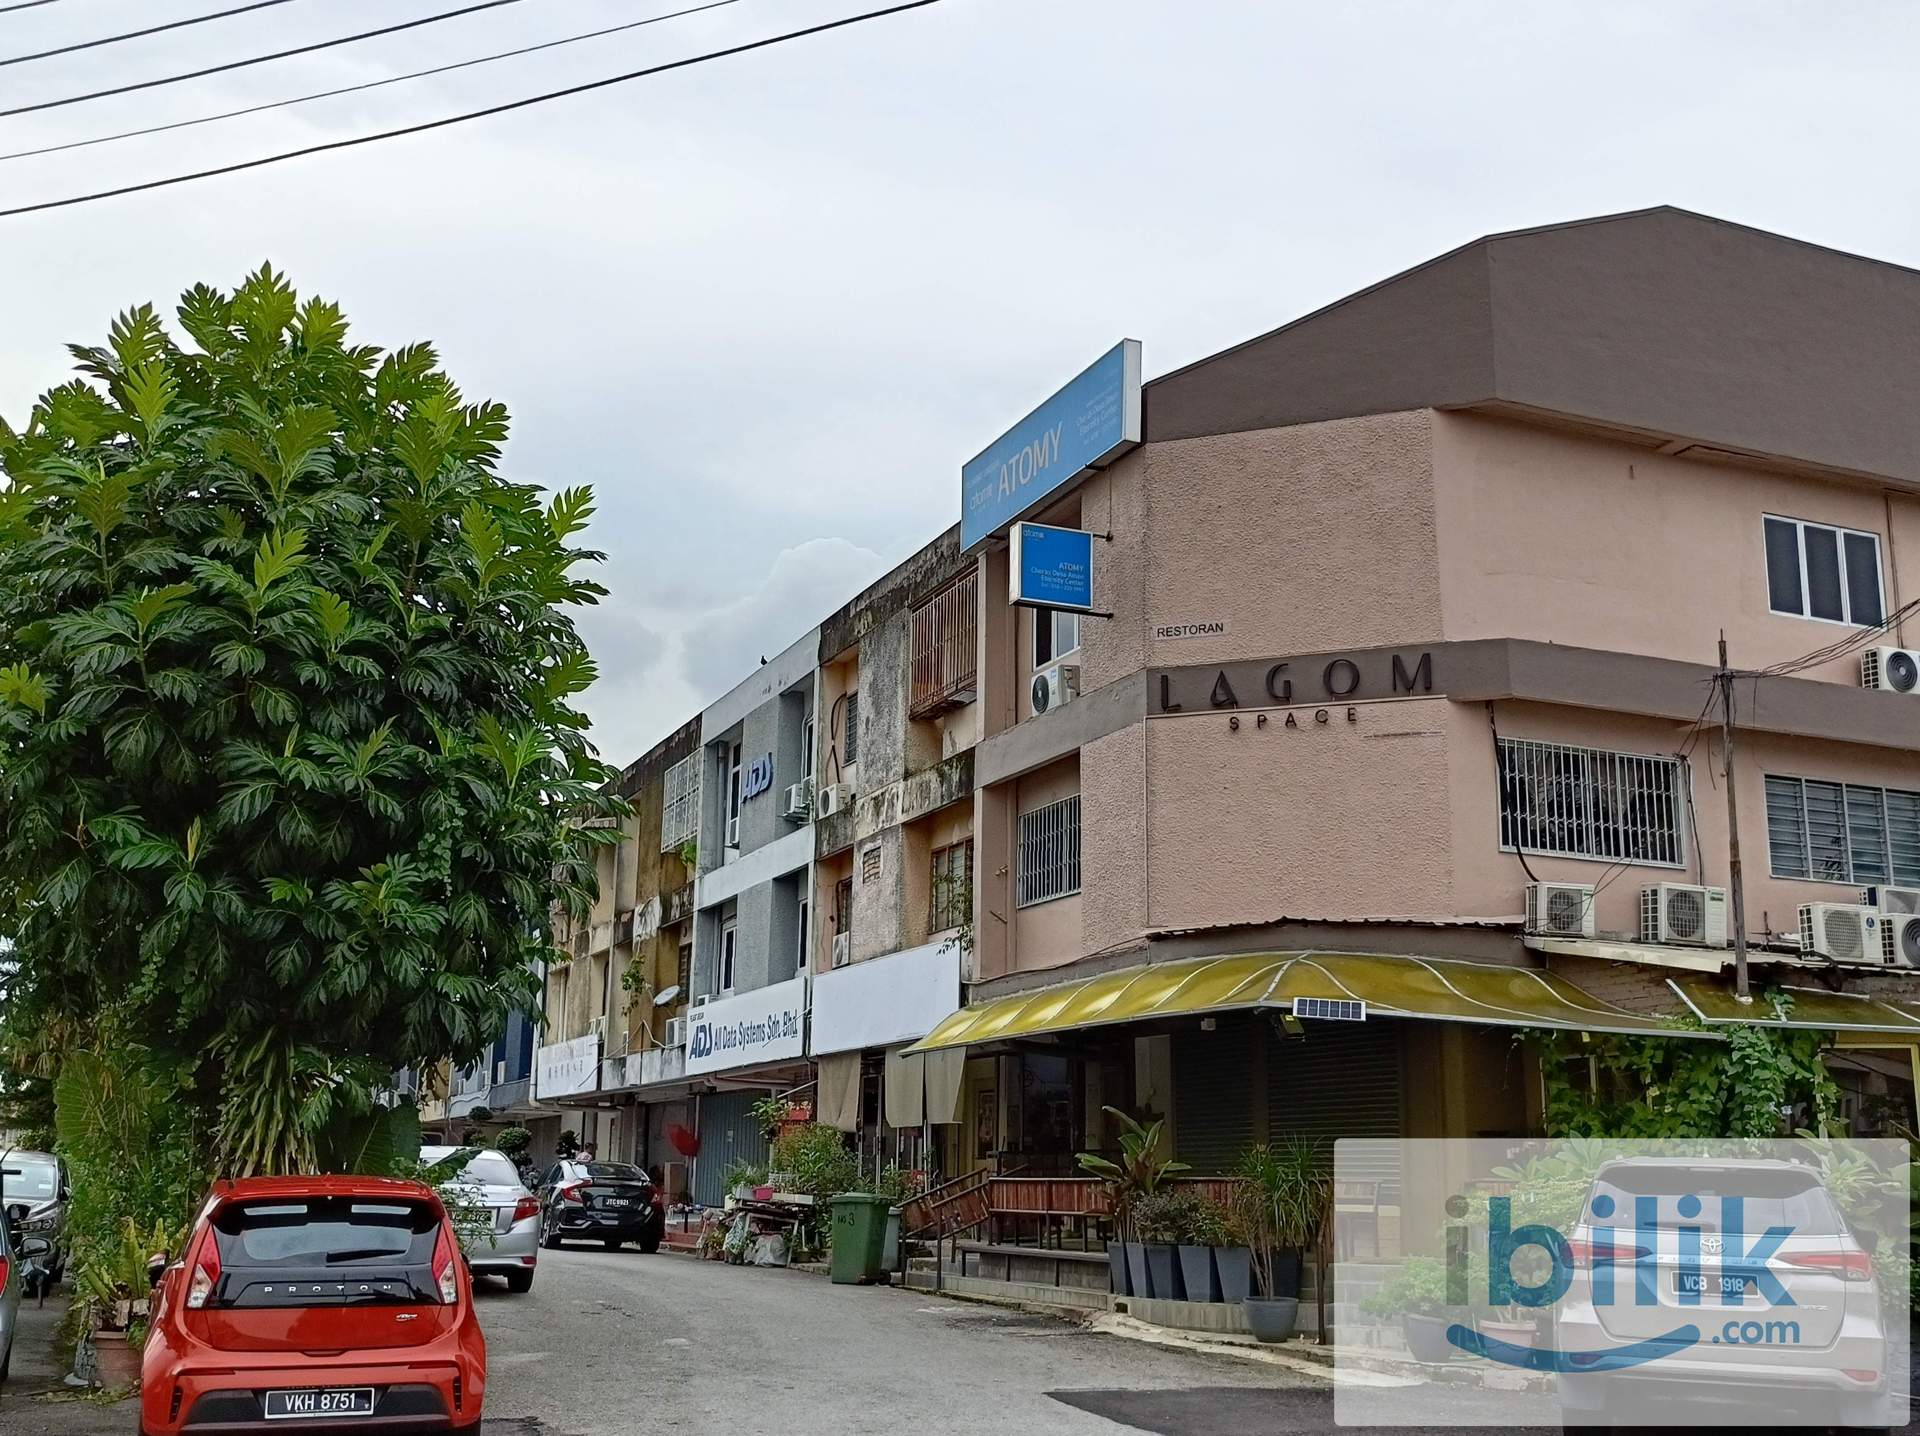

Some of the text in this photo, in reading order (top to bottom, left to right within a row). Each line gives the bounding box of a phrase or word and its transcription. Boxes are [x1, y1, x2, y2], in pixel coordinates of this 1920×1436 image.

[997, 420, 1064, 498] ATOMY
[1157, 622, 1225, 638] RESTORAN
[1160, 653, 1434, 712] LAGOM
[1228, 707, 1358, 732] SPACE
[723, 1025, 737, 1050] Data
[739, 1020, 766, 1051] Systems
[848, 1212, 855, 1226] 3
[264, 1284, 391, 1293] PROTON
[1683, 1275, 1744, 1292] VCB 1918
[285, 1393, 355, 1411] VKH 8751
